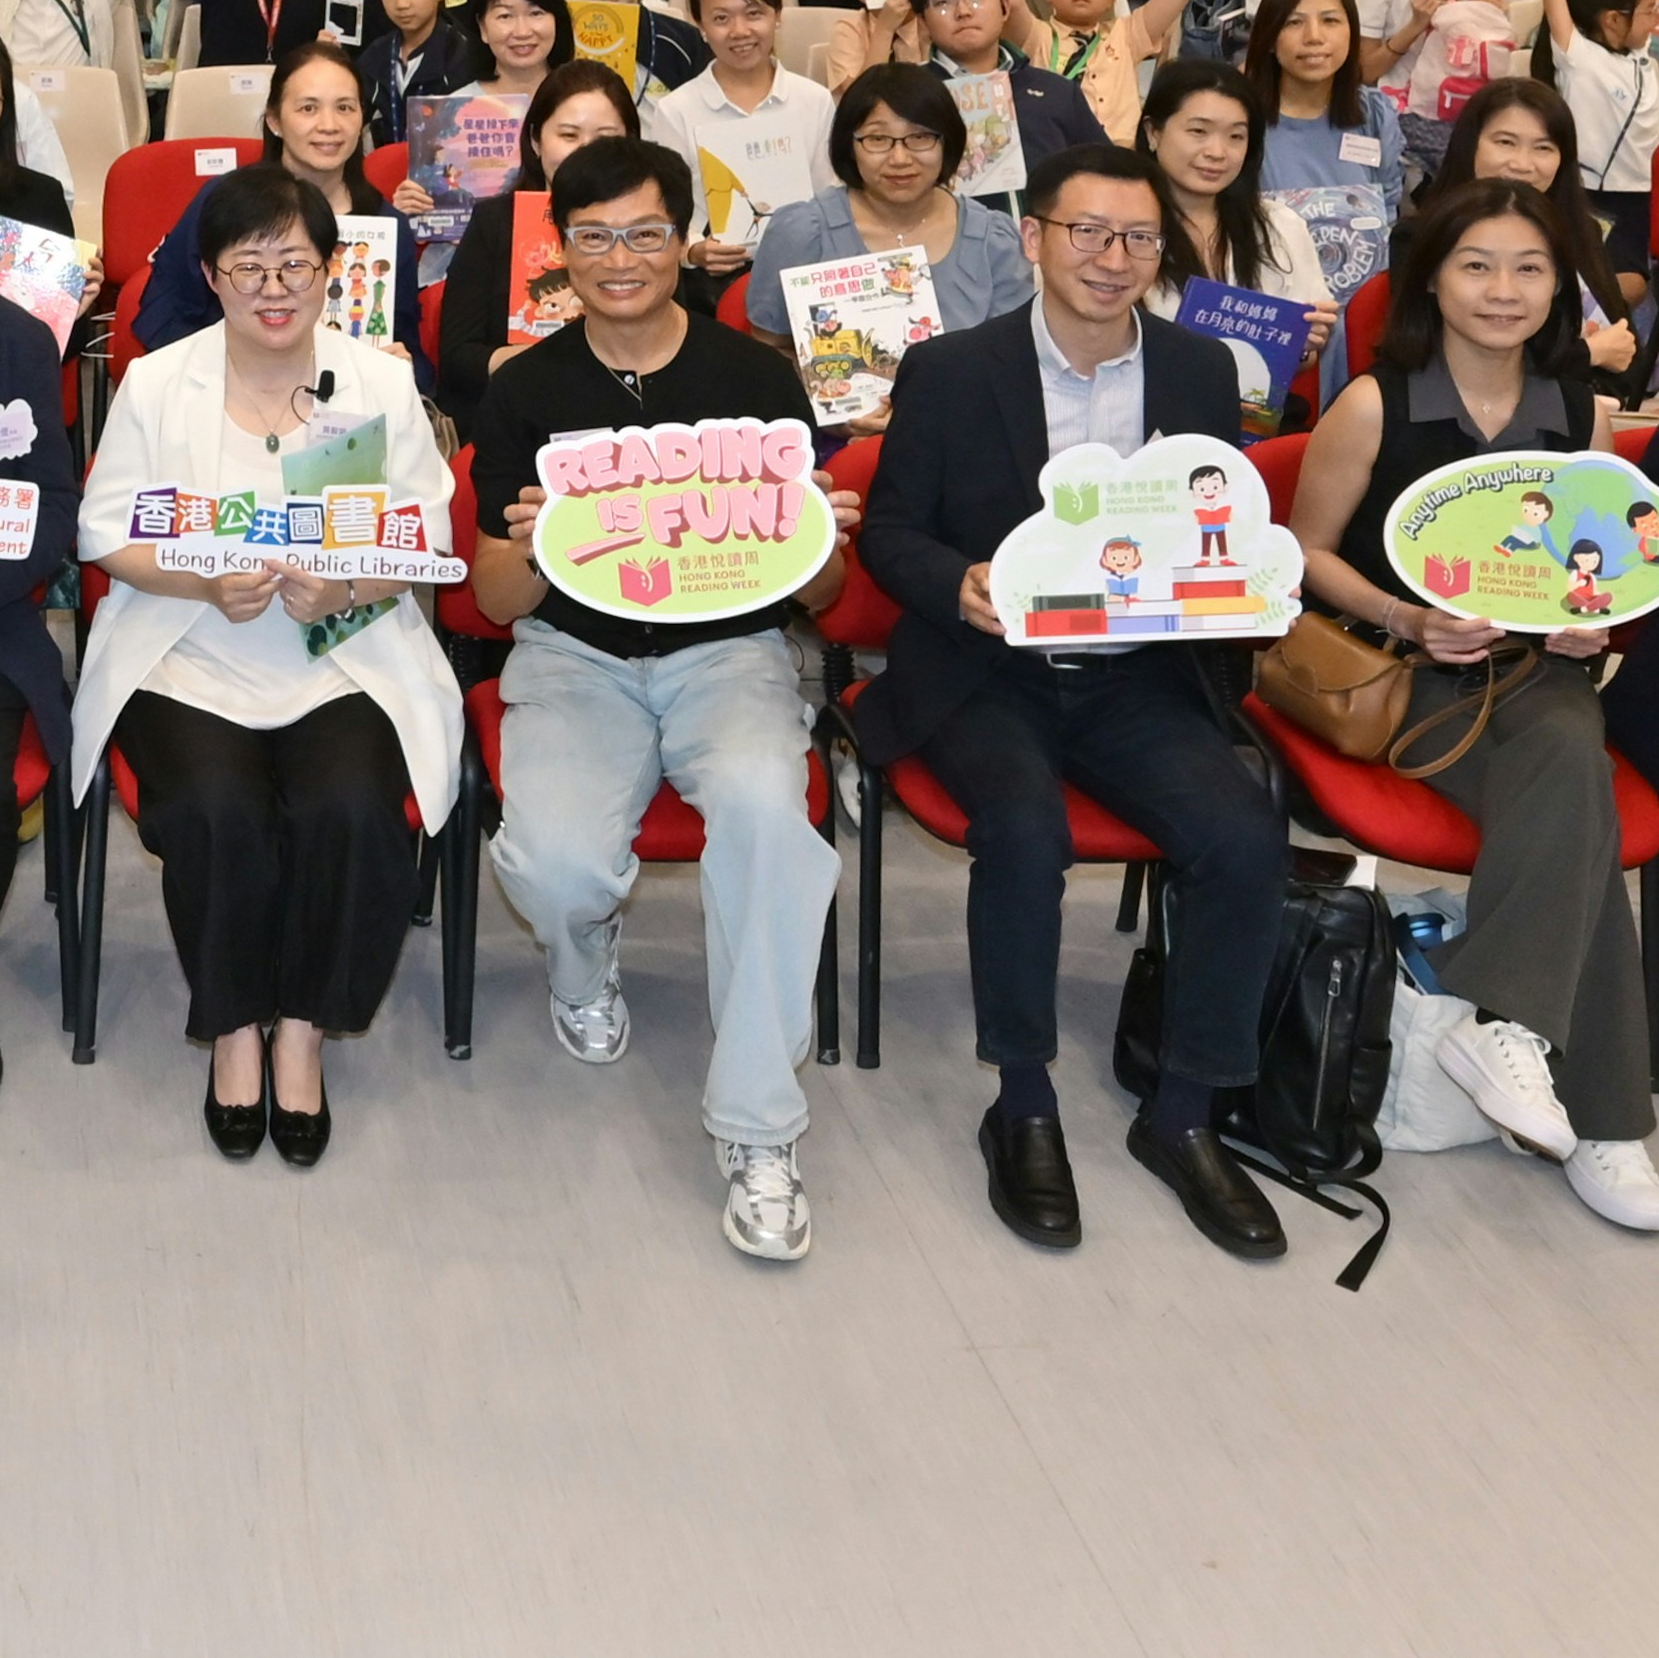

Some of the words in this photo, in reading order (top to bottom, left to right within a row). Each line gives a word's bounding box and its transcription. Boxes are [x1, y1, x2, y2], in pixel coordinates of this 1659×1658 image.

[1299, 200, 1337, 221] THE
[543, 427, 808, 495] READING
[1398, 480, 1462, 540] Anytime
[1463, 463, 1555, 495] Anywhere
[134, 488, 425, 551] 香港公共圖書館
[596, 494, 645, 533] IS
[644, 482, 806, 547] FUN!
[160, 548, 215, 575] Hong
[222, 549, 266, 572] Kon
[359, 556, 463, 579] Libraries
[677, 550, 760, 572] 香港悅讀周
[1477, 559, 1553, 580] 香港悅讀周
[679, 570, 713, 583] HONG
[714, 570, 746, 581] KONG
[680, 582, 729, 595] READING
[730, 578, 762, 591] WEEK
[1477, 576, 1506, 588] HONG
[1507, 578, 1538, 590] KONG
[1477, 586, 1520, 598] READING
[1521, 590, 1551, 601] WEEK
